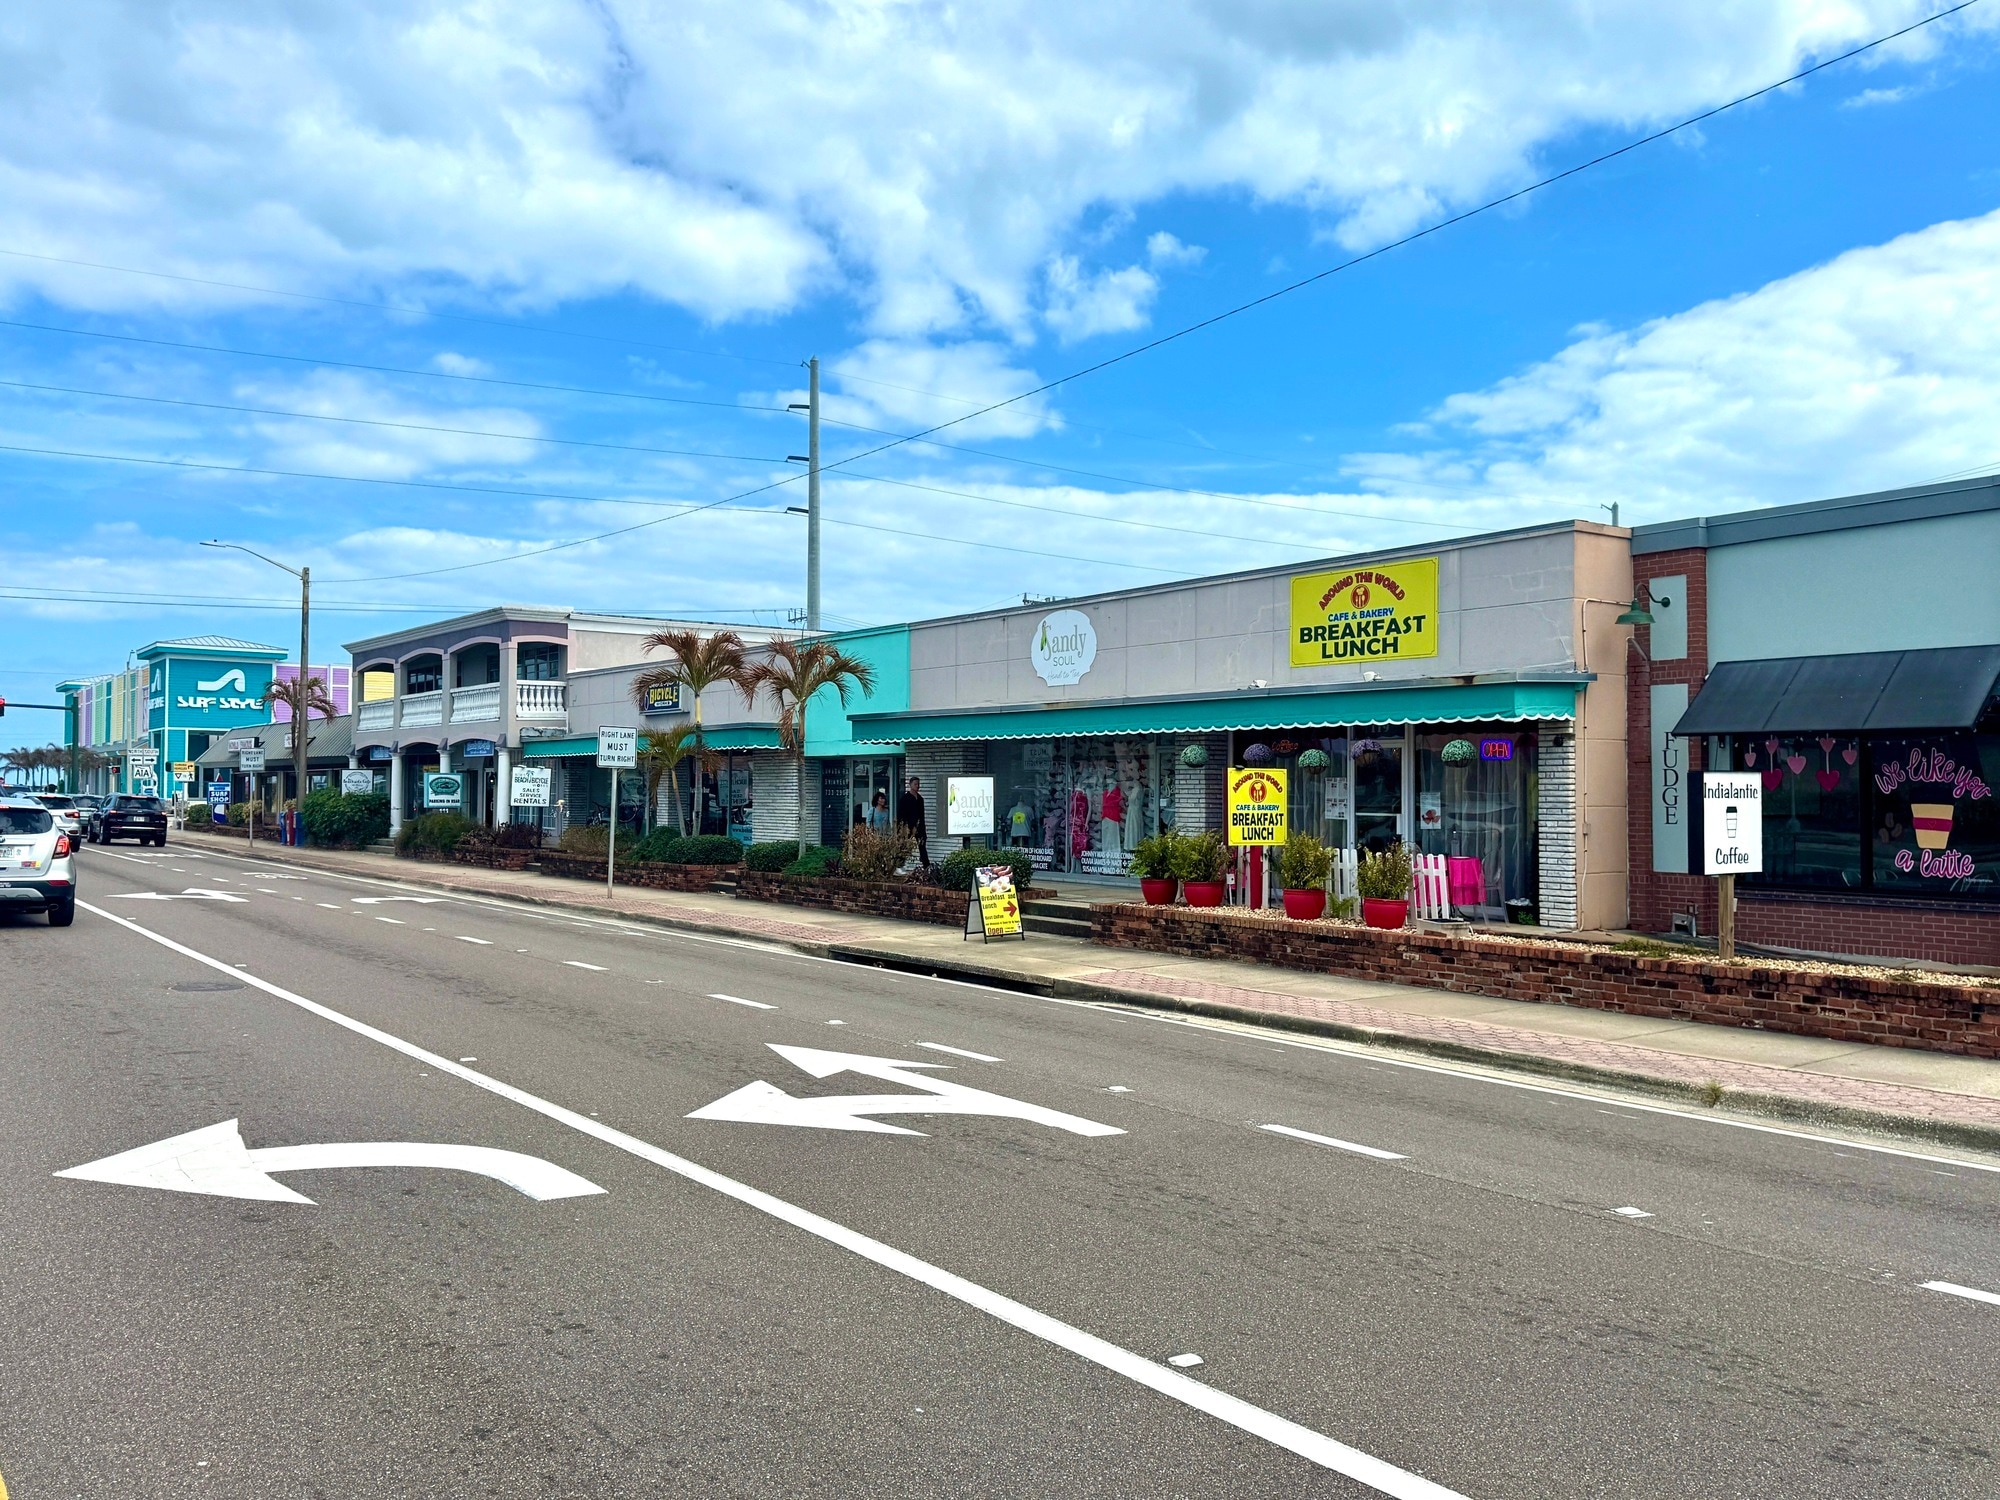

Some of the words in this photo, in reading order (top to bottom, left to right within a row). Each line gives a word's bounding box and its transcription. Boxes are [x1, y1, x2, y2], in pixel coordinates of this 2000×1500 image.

[1318, 575, 1354, 610] AROUND
[1354, 572, 1373, 583] THE
[1375, 573, 1405, 601] WORLD
[1328, 612, 1349, 622] CAFE
[1351, 611, 1357, 619] &
[1359, 607, 1394, 619] BAKERY
[1299, 615, 1426, 643] BREAKFAST
[1041, 620, 1087, 661] Sandy
[1321, 637, 1399, 659] LUNCH
[1053, 655, 1075, 667] SOUL
[1047, 671, 1062, 680] Head
[1063, 670, 1070, 679] to
[177, 696, 216, 708] SURF
[219, 697, 264, 710] STYLE
[650, 686, 678, 705] BICYCLE
[601, 731, 618, 739] RIGHT
[607, 743, 628, 751] MUST
[1483, 742, 1510, 758] OPEN
[1906, 748, 1955, 783] like
[1233, 773, 1254, 793] AROUND
[1266, 774, 1283, 793] WORLD
[1662, 732, 1679, 825] FUDGE
[949, 784, 992, 813] Sandy
[1703, 782, 1758, 799] Indialantic
[962, 810, 983, 818] SOUL
[1232, 813, 1284, 826] BREAKFAST
[1242, 827, 1274, 840] LUNCH
[1715, 847, 1749, 864] Coffee
[1895, 849, 1914, 872] a
[1920, 849, 1975, 878] latte
[987, 927, 1004, 935] Open
